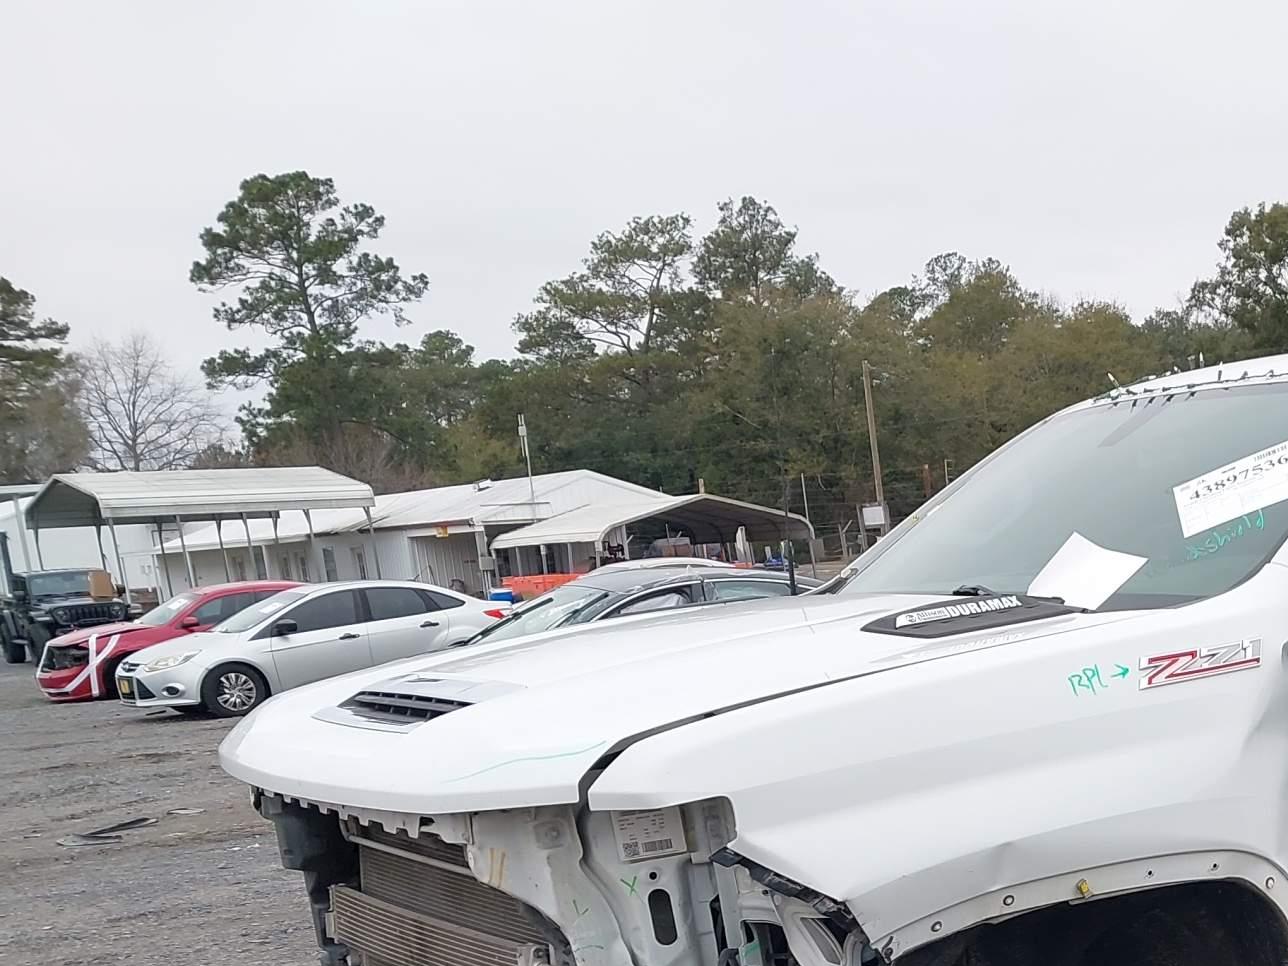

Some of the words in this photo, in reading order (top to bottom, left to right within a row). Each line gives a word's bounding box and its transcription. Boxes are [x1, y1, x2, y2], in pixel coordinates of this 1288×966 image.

[1189, 455, 1288, 500] 43897536
[949, 595, 1022, 618] DURAMAX
[1138, 637, 1262, 690] Z71
